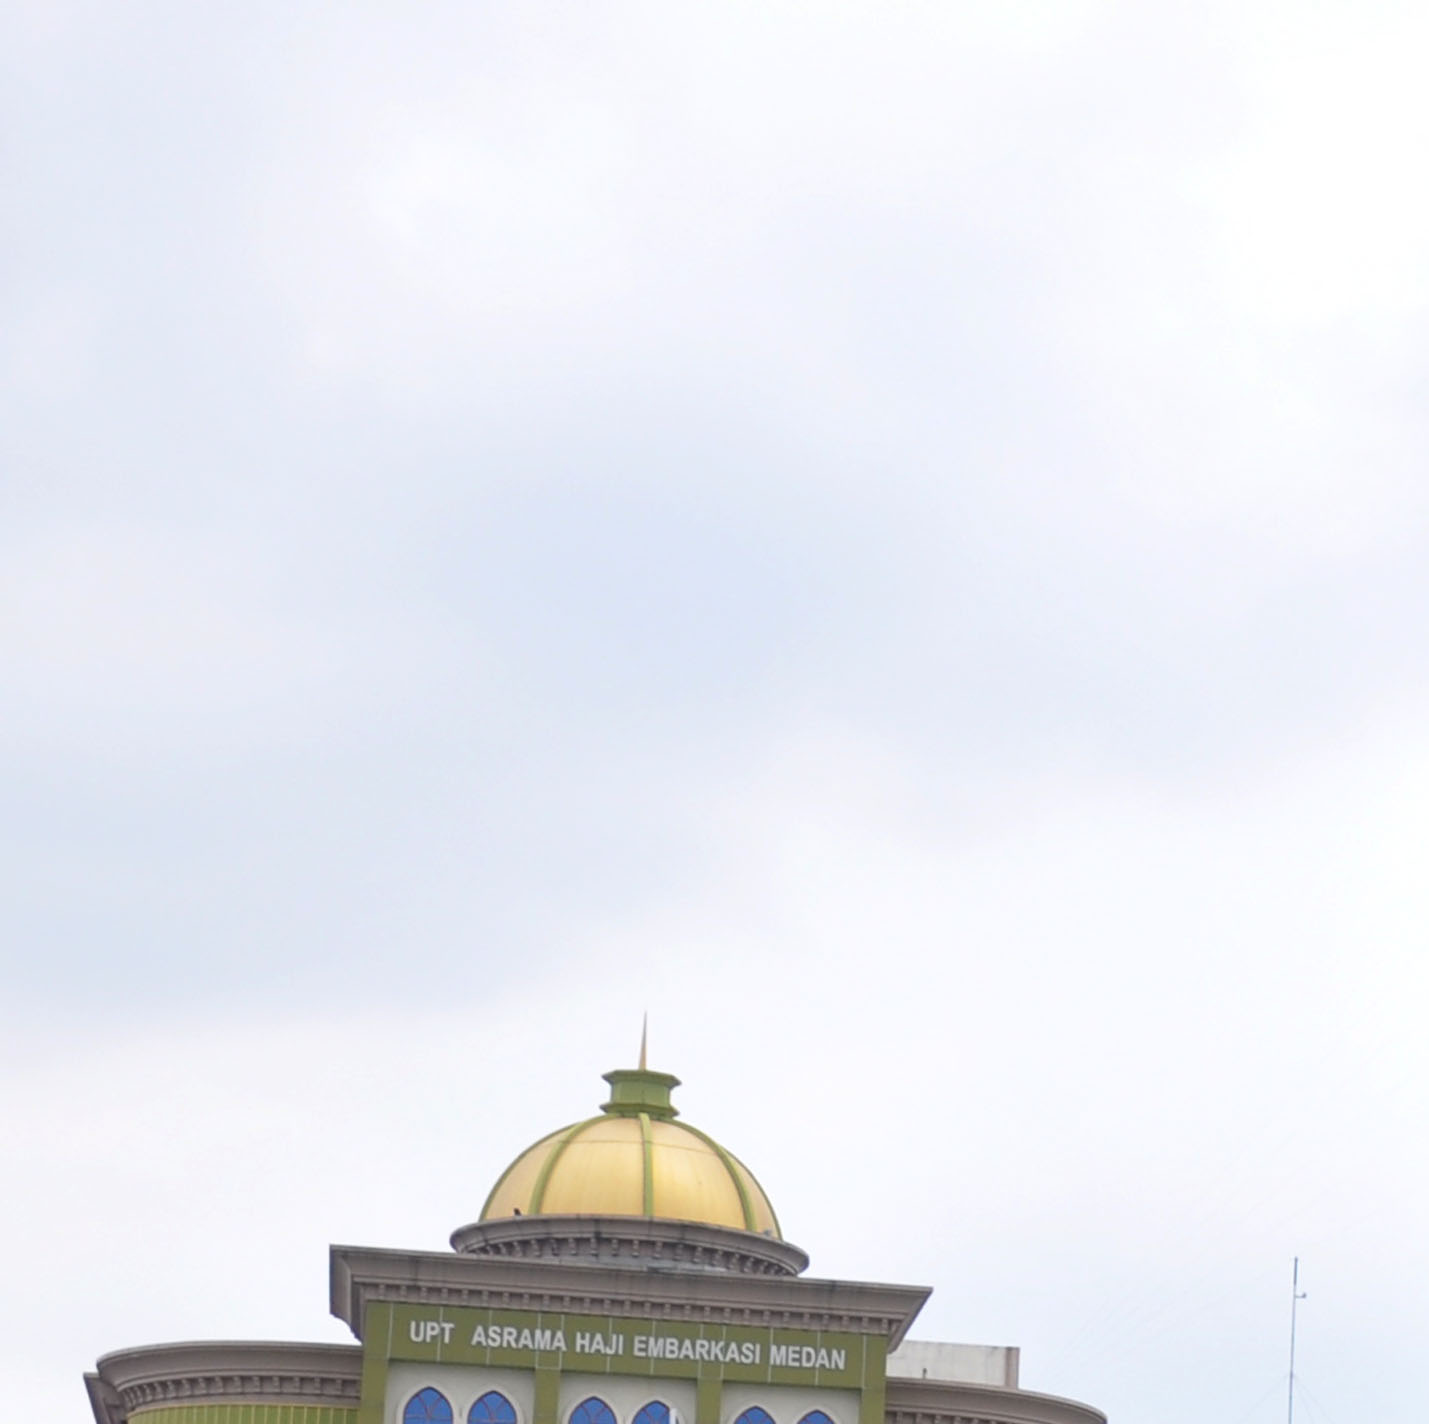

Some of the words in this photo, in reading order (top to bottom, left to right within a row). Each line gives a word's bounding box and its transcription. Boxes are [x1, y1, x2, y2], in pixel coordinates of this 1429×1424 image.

[410, 1320, 455, 1344] UPT
[471, 1325, 567, 1351] ASRAMA
[575, 1332, 624, 1355] HAJI
[633, 1336, 761, 1365] EMBARKASI
[769, 1344, 845, 1370] MEDAN
